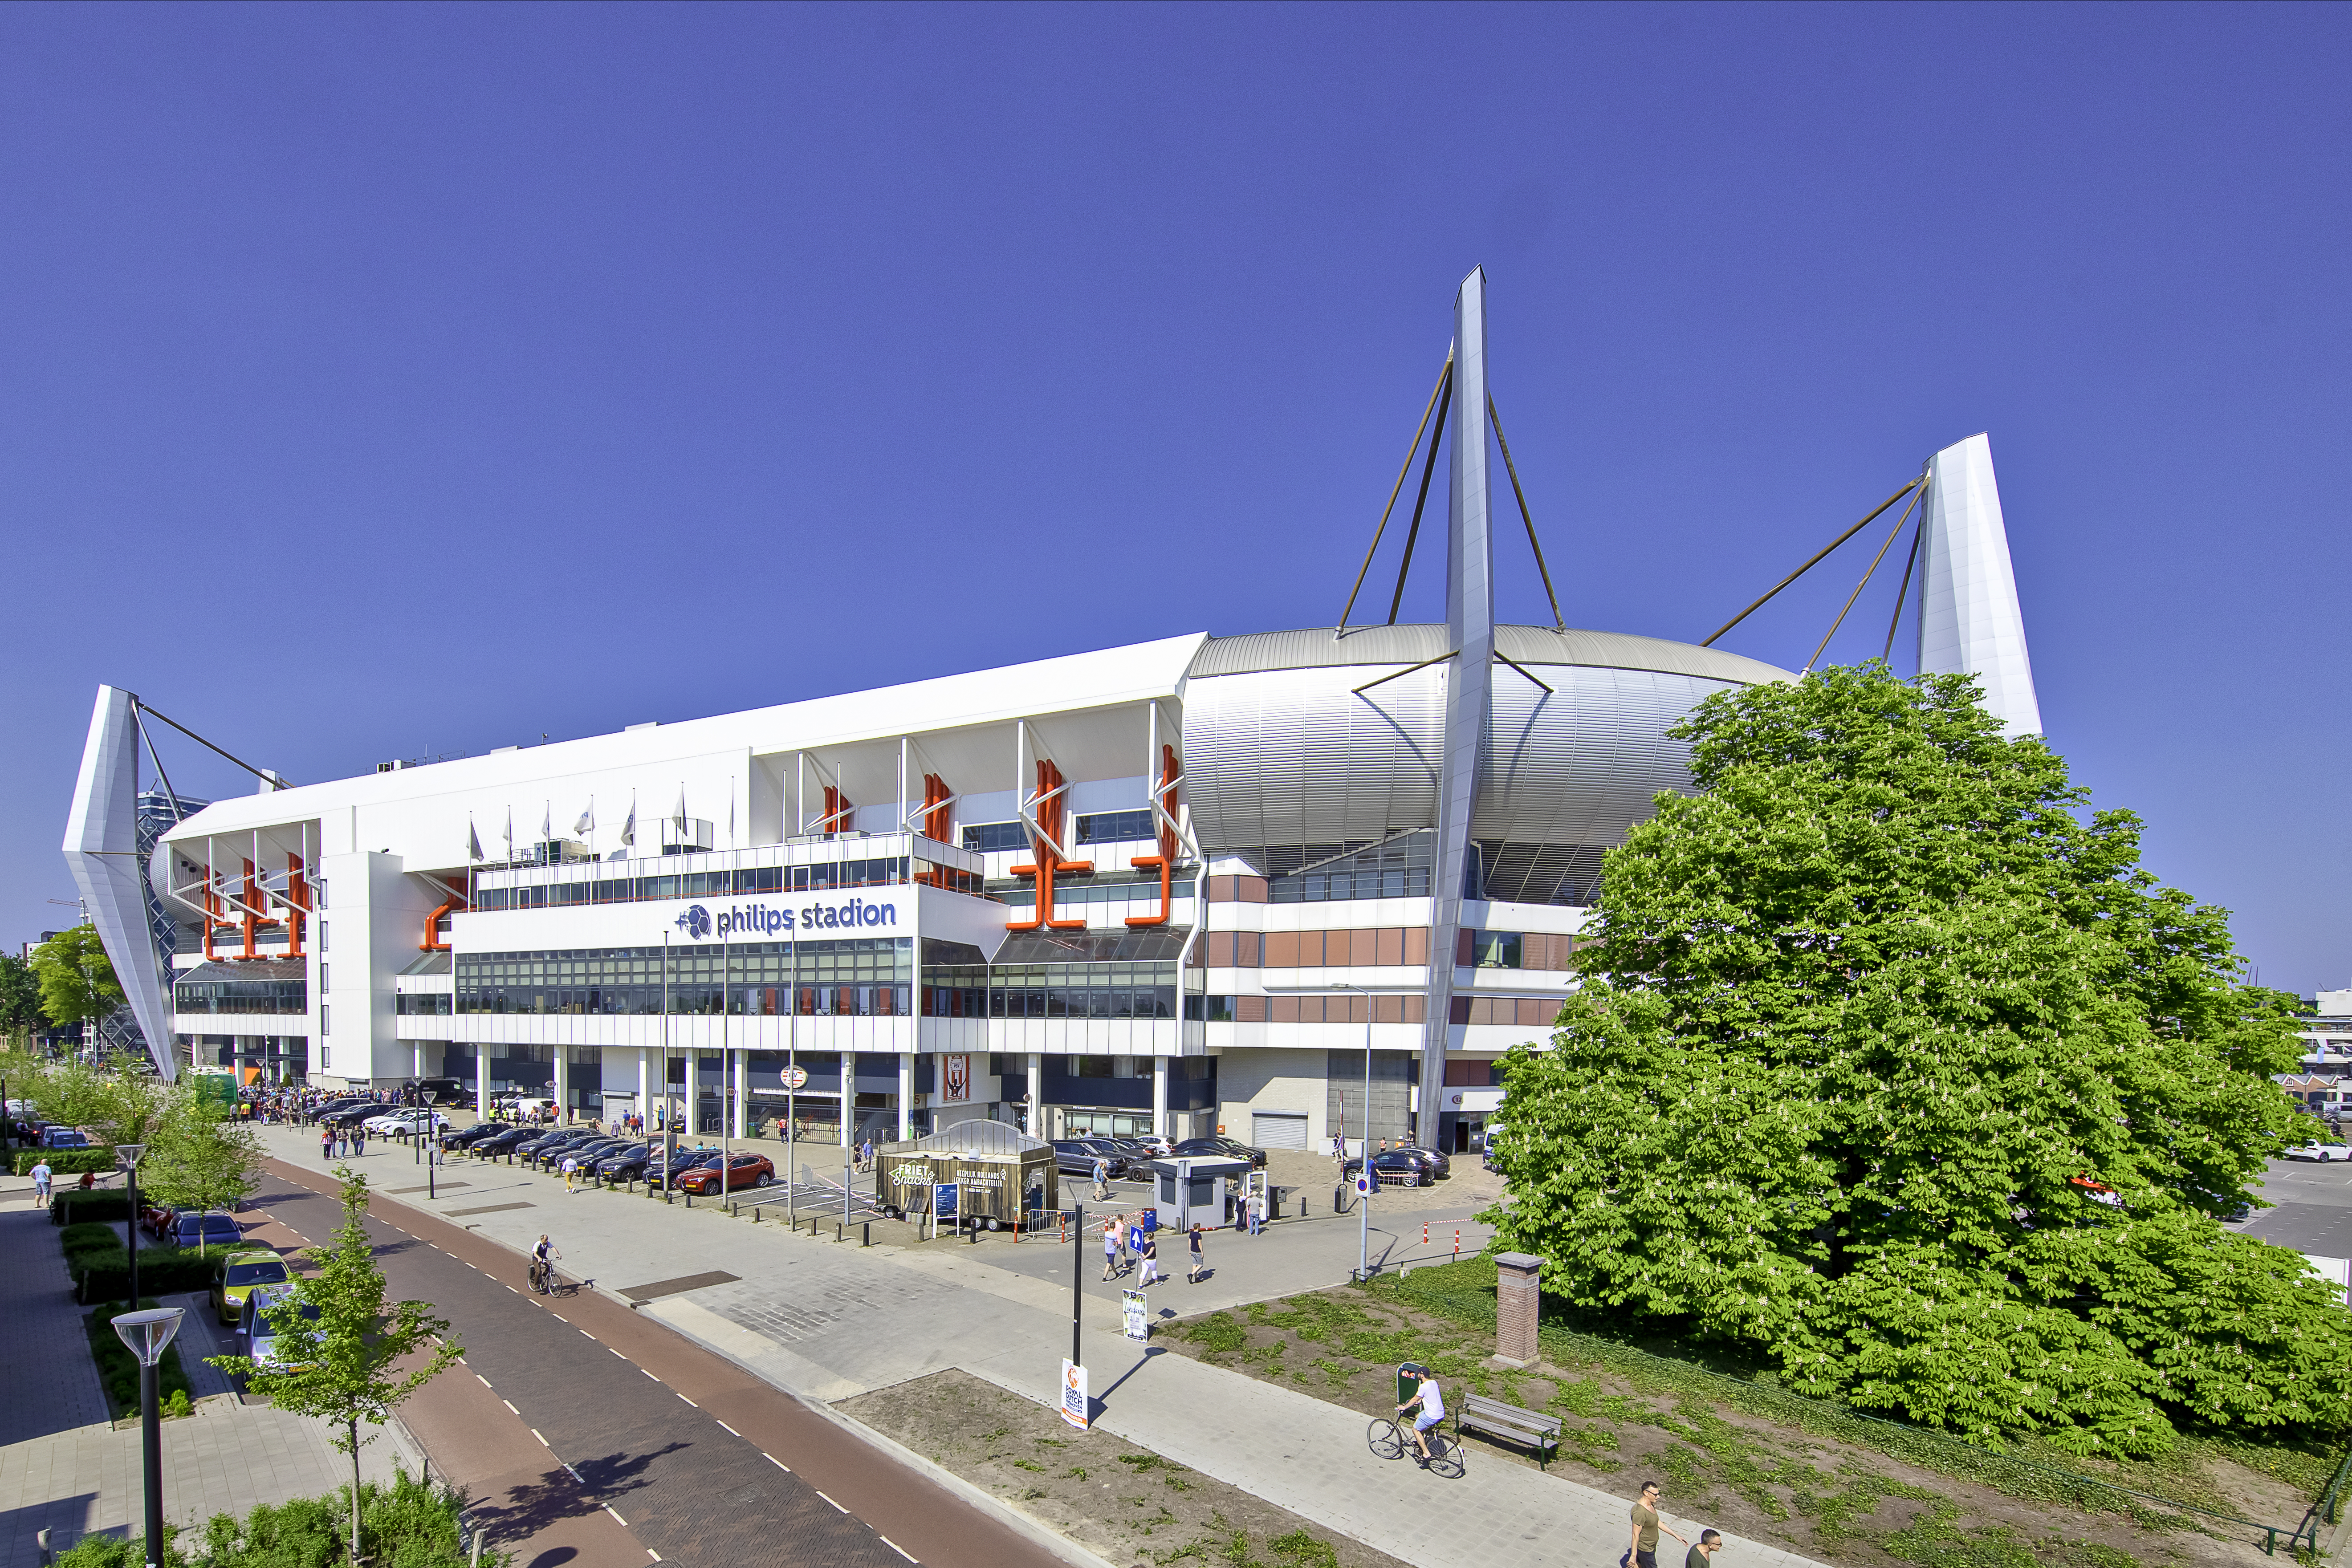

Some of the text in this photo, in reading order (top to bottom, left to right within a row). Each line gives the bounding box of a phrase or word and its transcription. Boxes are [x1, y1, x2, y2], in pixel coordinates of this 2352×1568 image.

[717, 898, 896, 938] philips stadion
[914, 1094, 920, 1104] 5
[899, 1164, 929, 1177] FRIET
[956, 1170, 1000, 1180] HEERLIJK HOLLANDS
[971, 1178, 1003, 1187] AMBACHTELIJK
[1066, 1385, 1082, 1398] ROYAL
[1066, 1392, 1082, 1406] DUTCH
